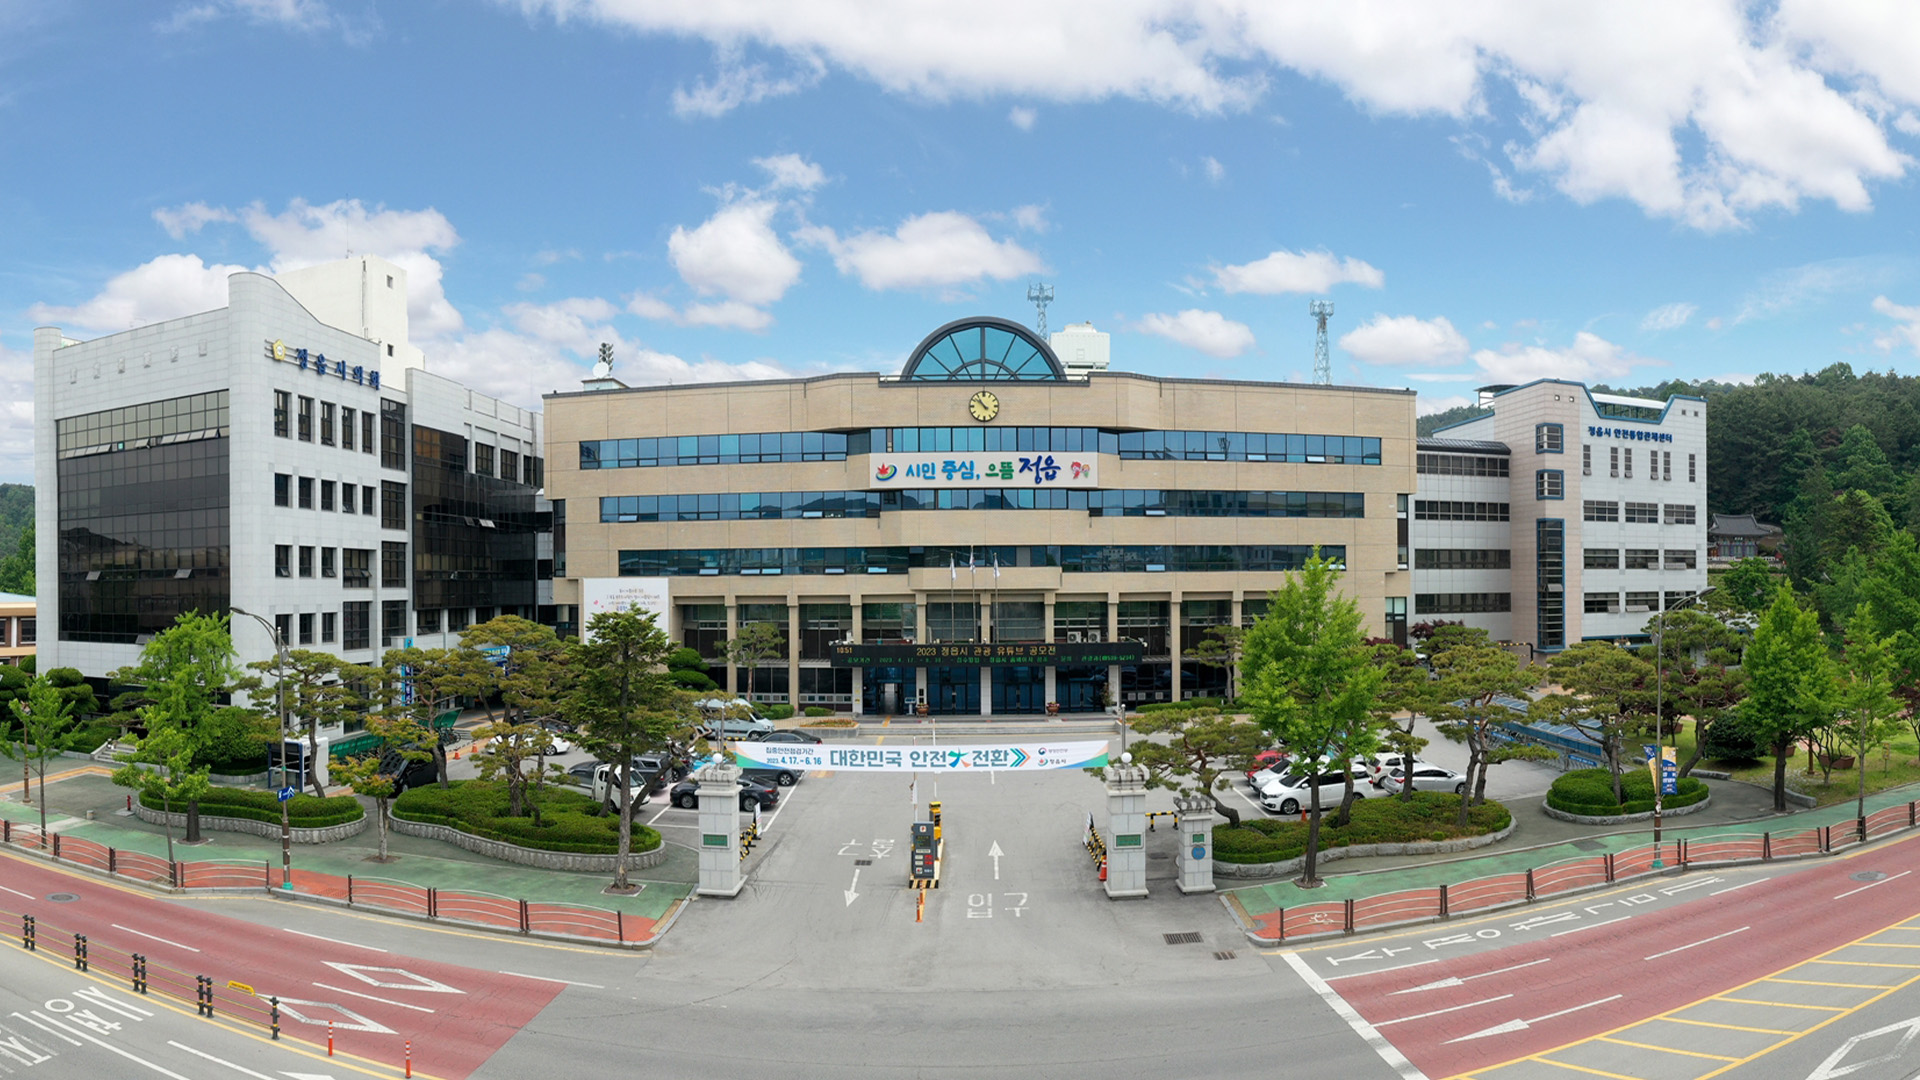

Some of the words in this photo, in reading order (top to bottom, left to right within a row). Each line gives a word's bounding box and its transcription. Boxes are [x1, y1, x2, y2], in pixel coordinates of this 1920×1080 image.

[296, 348, 380, 391] 정읍시의회
[1588, 426, 1612, 438] 정읍시
[1613, 428, 1673, 443] 안전통합관제센터
[905, 461, 936, 480] 시민
[941, 460, 980, 481] 중심,
[985, 461, 1015, 480] 으뜸
[1018, 455, 1061, 484] 정읍
[916, 647, 937, 656] 2023
[941, 646, 969, 656] 정읍시
[973, 646, 992, 656] 관광
[997, 645, 1024, 656] 유튜브
[1029, 645, 1056, 656] 공모전
[830, 749, 902, 768] 대한민국
[966, 892, 1030, 918] 입구
